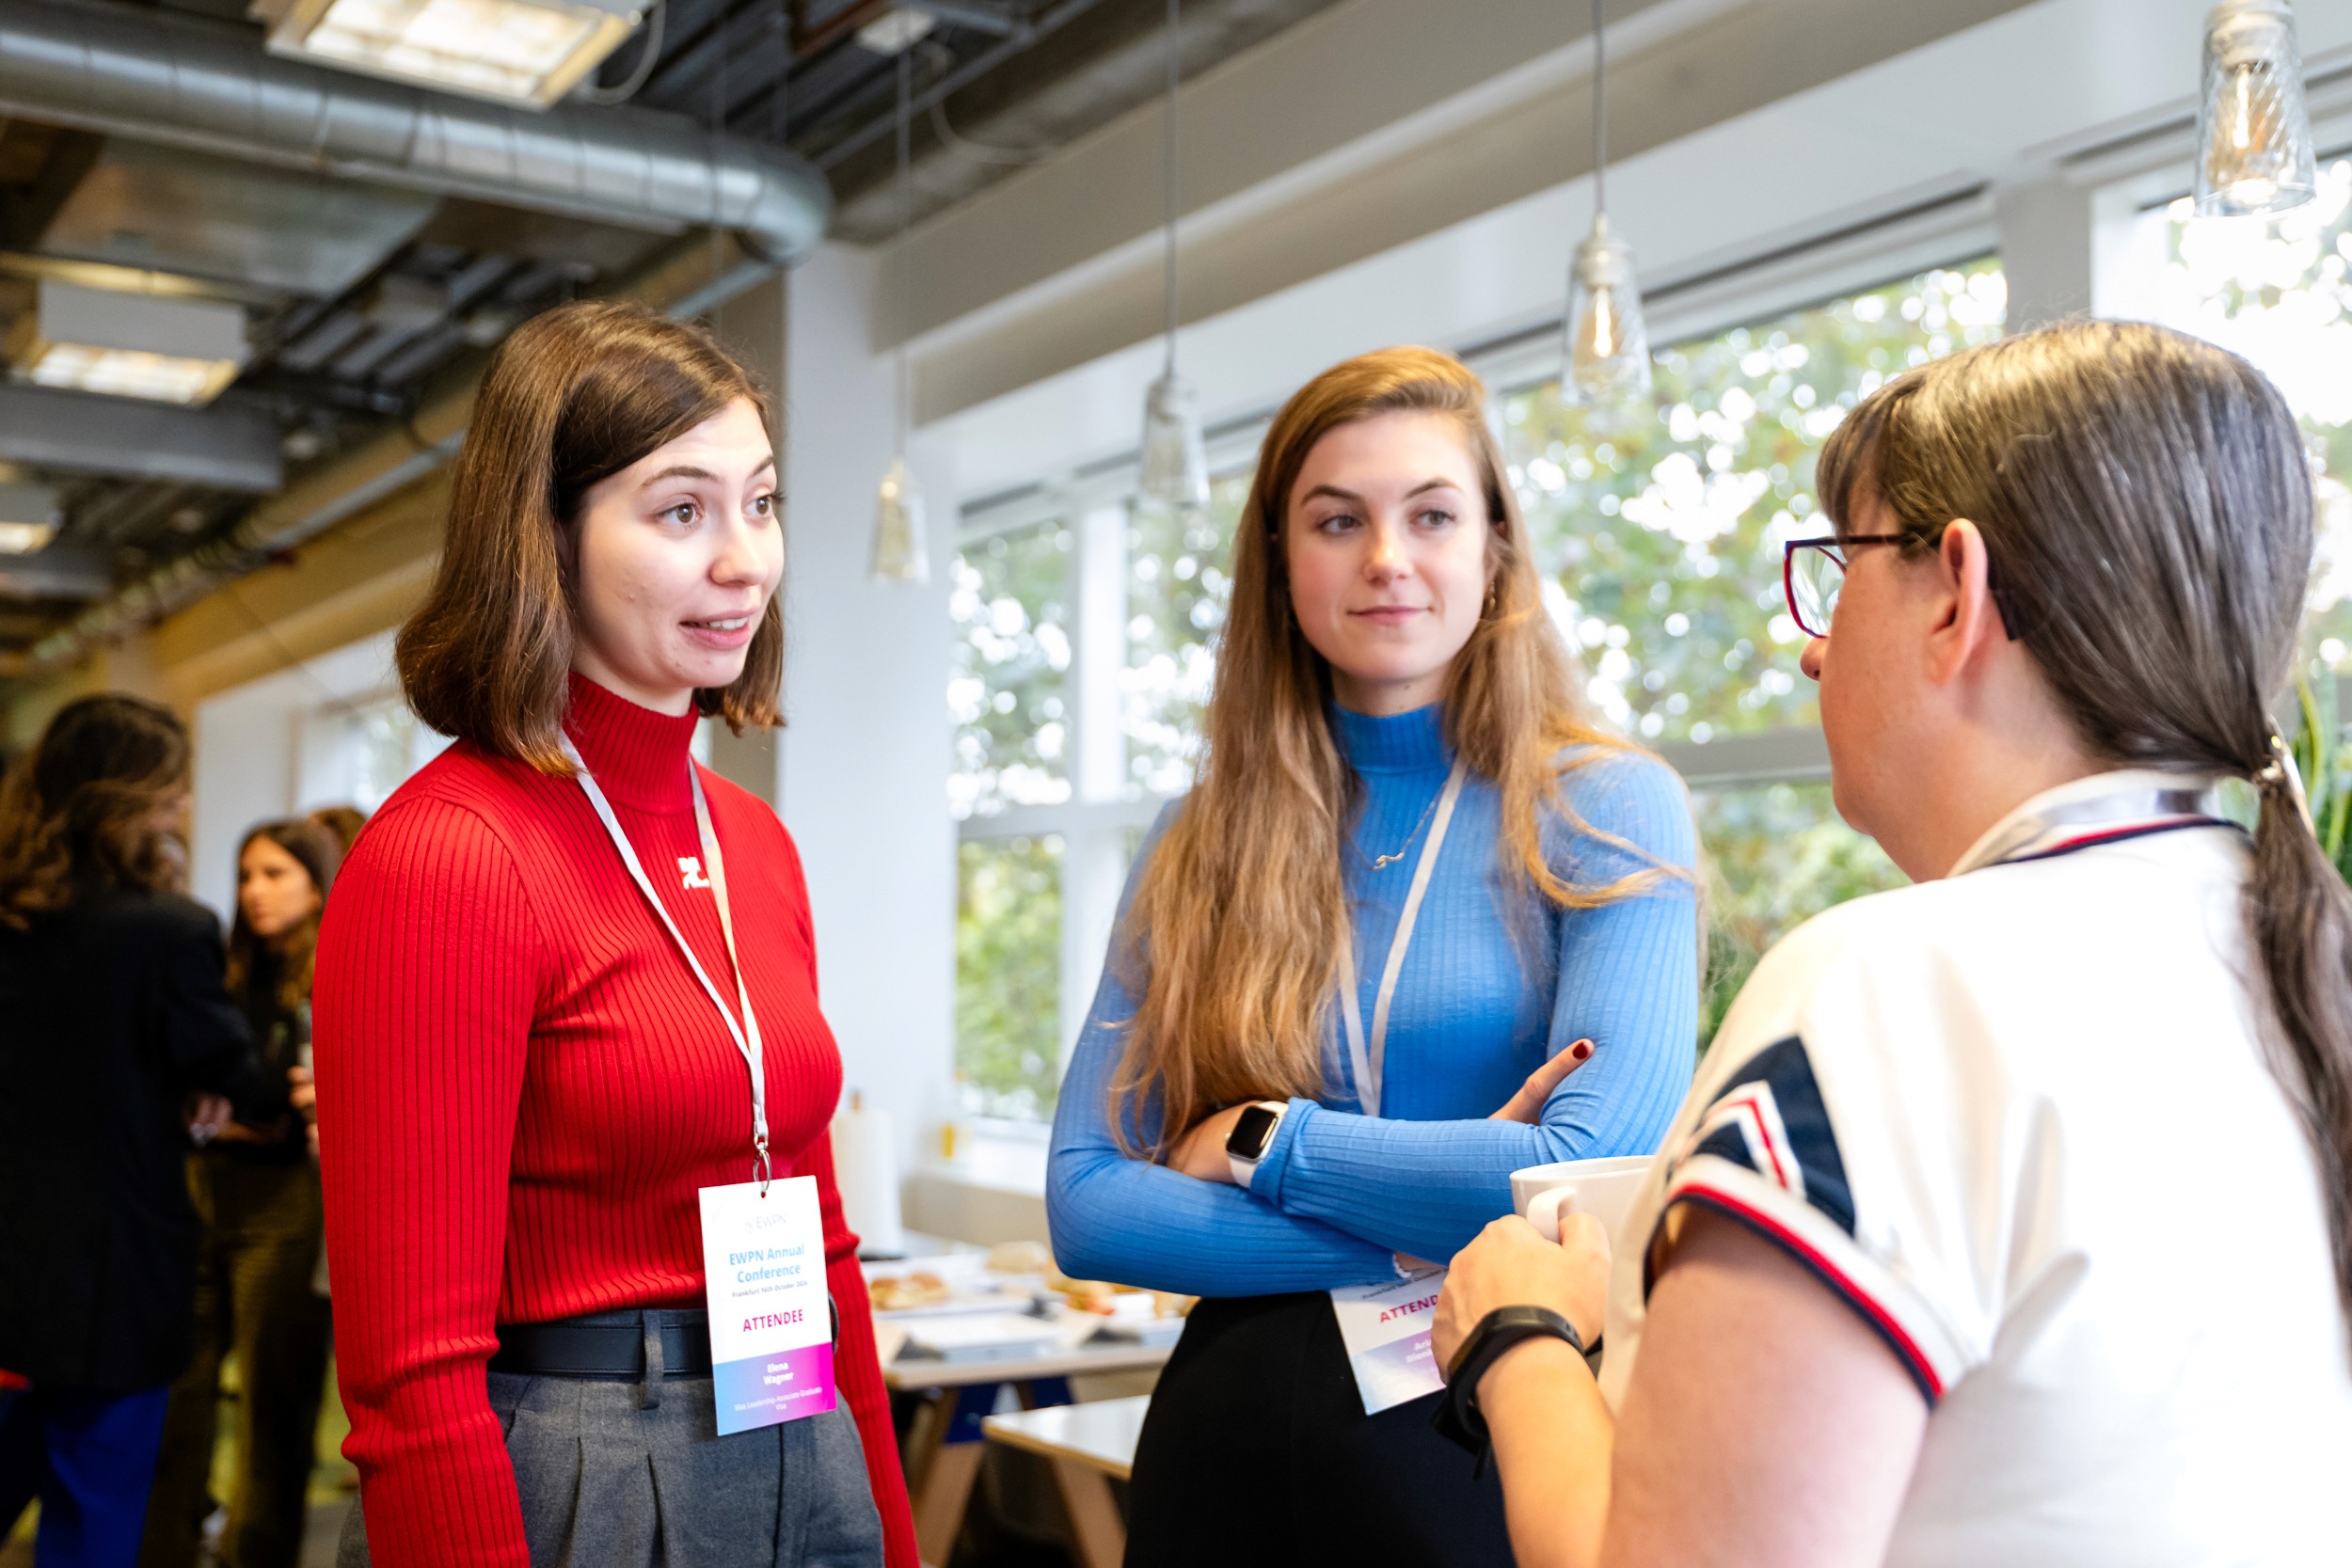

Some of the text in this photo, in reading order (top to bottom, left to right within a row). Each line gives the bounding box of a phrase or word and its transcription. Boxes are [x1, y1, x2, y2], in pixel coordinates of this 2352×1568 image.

[729, 1243, 804, 1265] EWPN Annual
[738, 1264, 801, 1283] Conference
[732, 1288, 759, 1298] Frankfurt
[774, 1281, 795, 1291] October
[1380, 1294, 1438, 1323] ATTEND
[743, 1309, 803, 1332] ATTENDEE
[767, 1362, 788, 1373] Elena
[763, 1372, 794, 1386] Wagner
